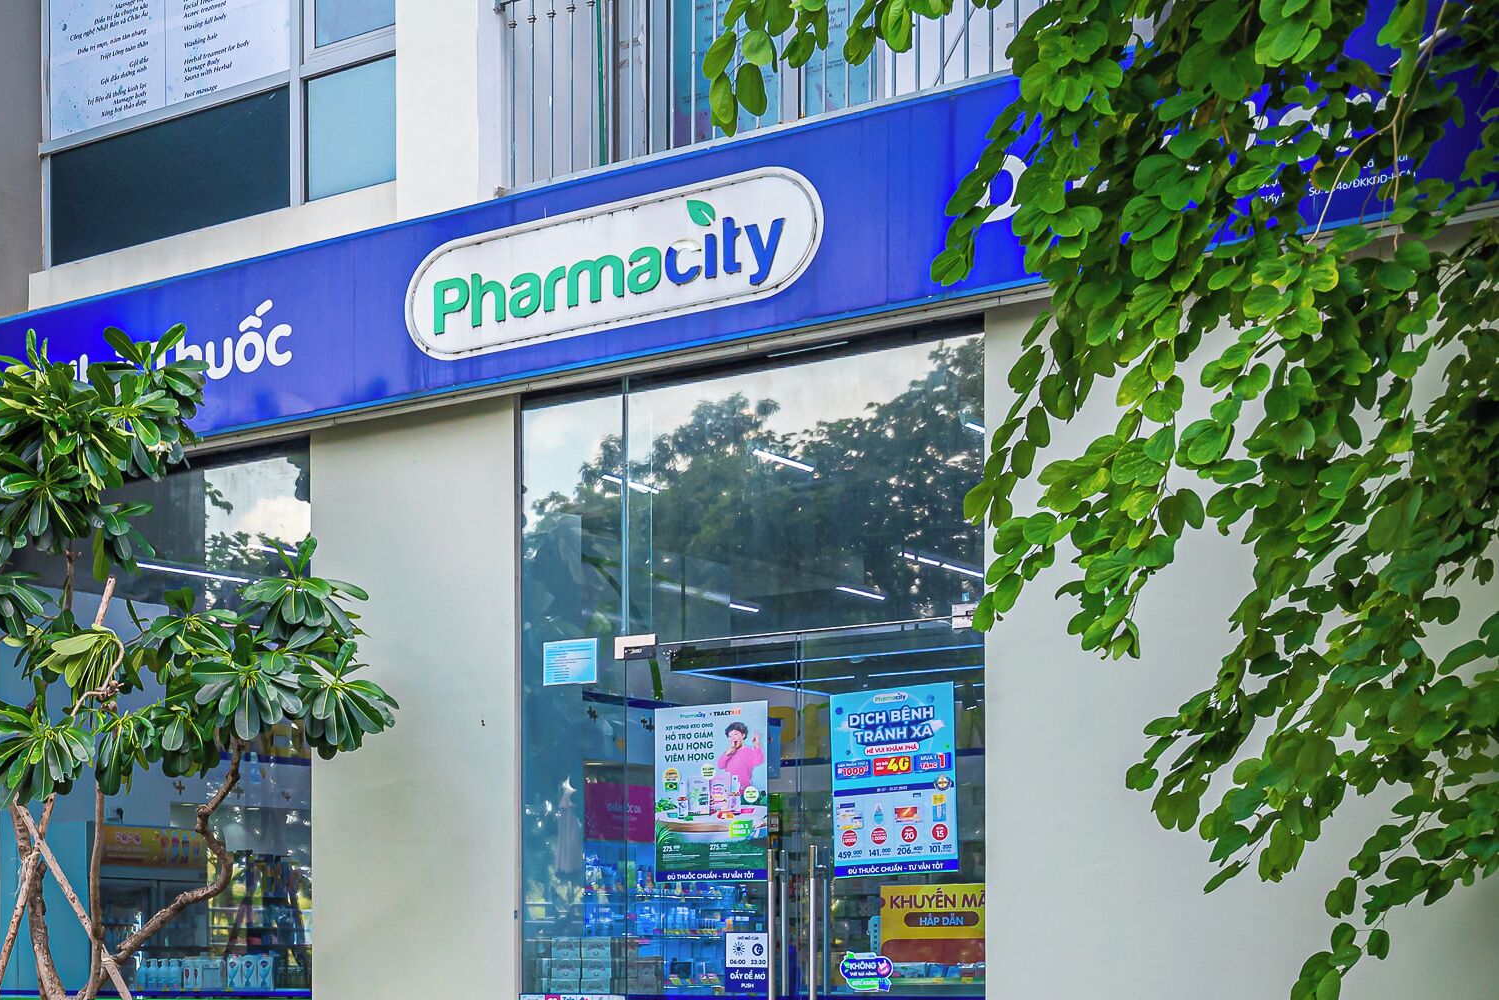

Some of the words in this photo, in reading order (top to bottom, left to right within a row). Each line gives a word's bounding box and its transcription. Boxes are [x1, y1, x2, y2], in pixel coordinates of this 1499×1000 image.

[434, 200, 786, 335] Pharmacity
[849, 710, 887, 729] DỊCH
[890, 706, 934, 725] BỆNH
[855, 725, 908, 743] TRÁNH
[910, 724, 933, 738] XA
[665, 743, 684, 751] ĐAU
[686, 740, 714, 751] HỌNG
[664, 752, 685, 763] VIÊM
[687, 752, 715, 762] HỌNG
[890, 887, 957, 910] KHUYẾN
[919, 912, 940, 926] HẤP
[942, 912, 964, 926] DẪN
[849, 960, 877, 970] KHÔNG
